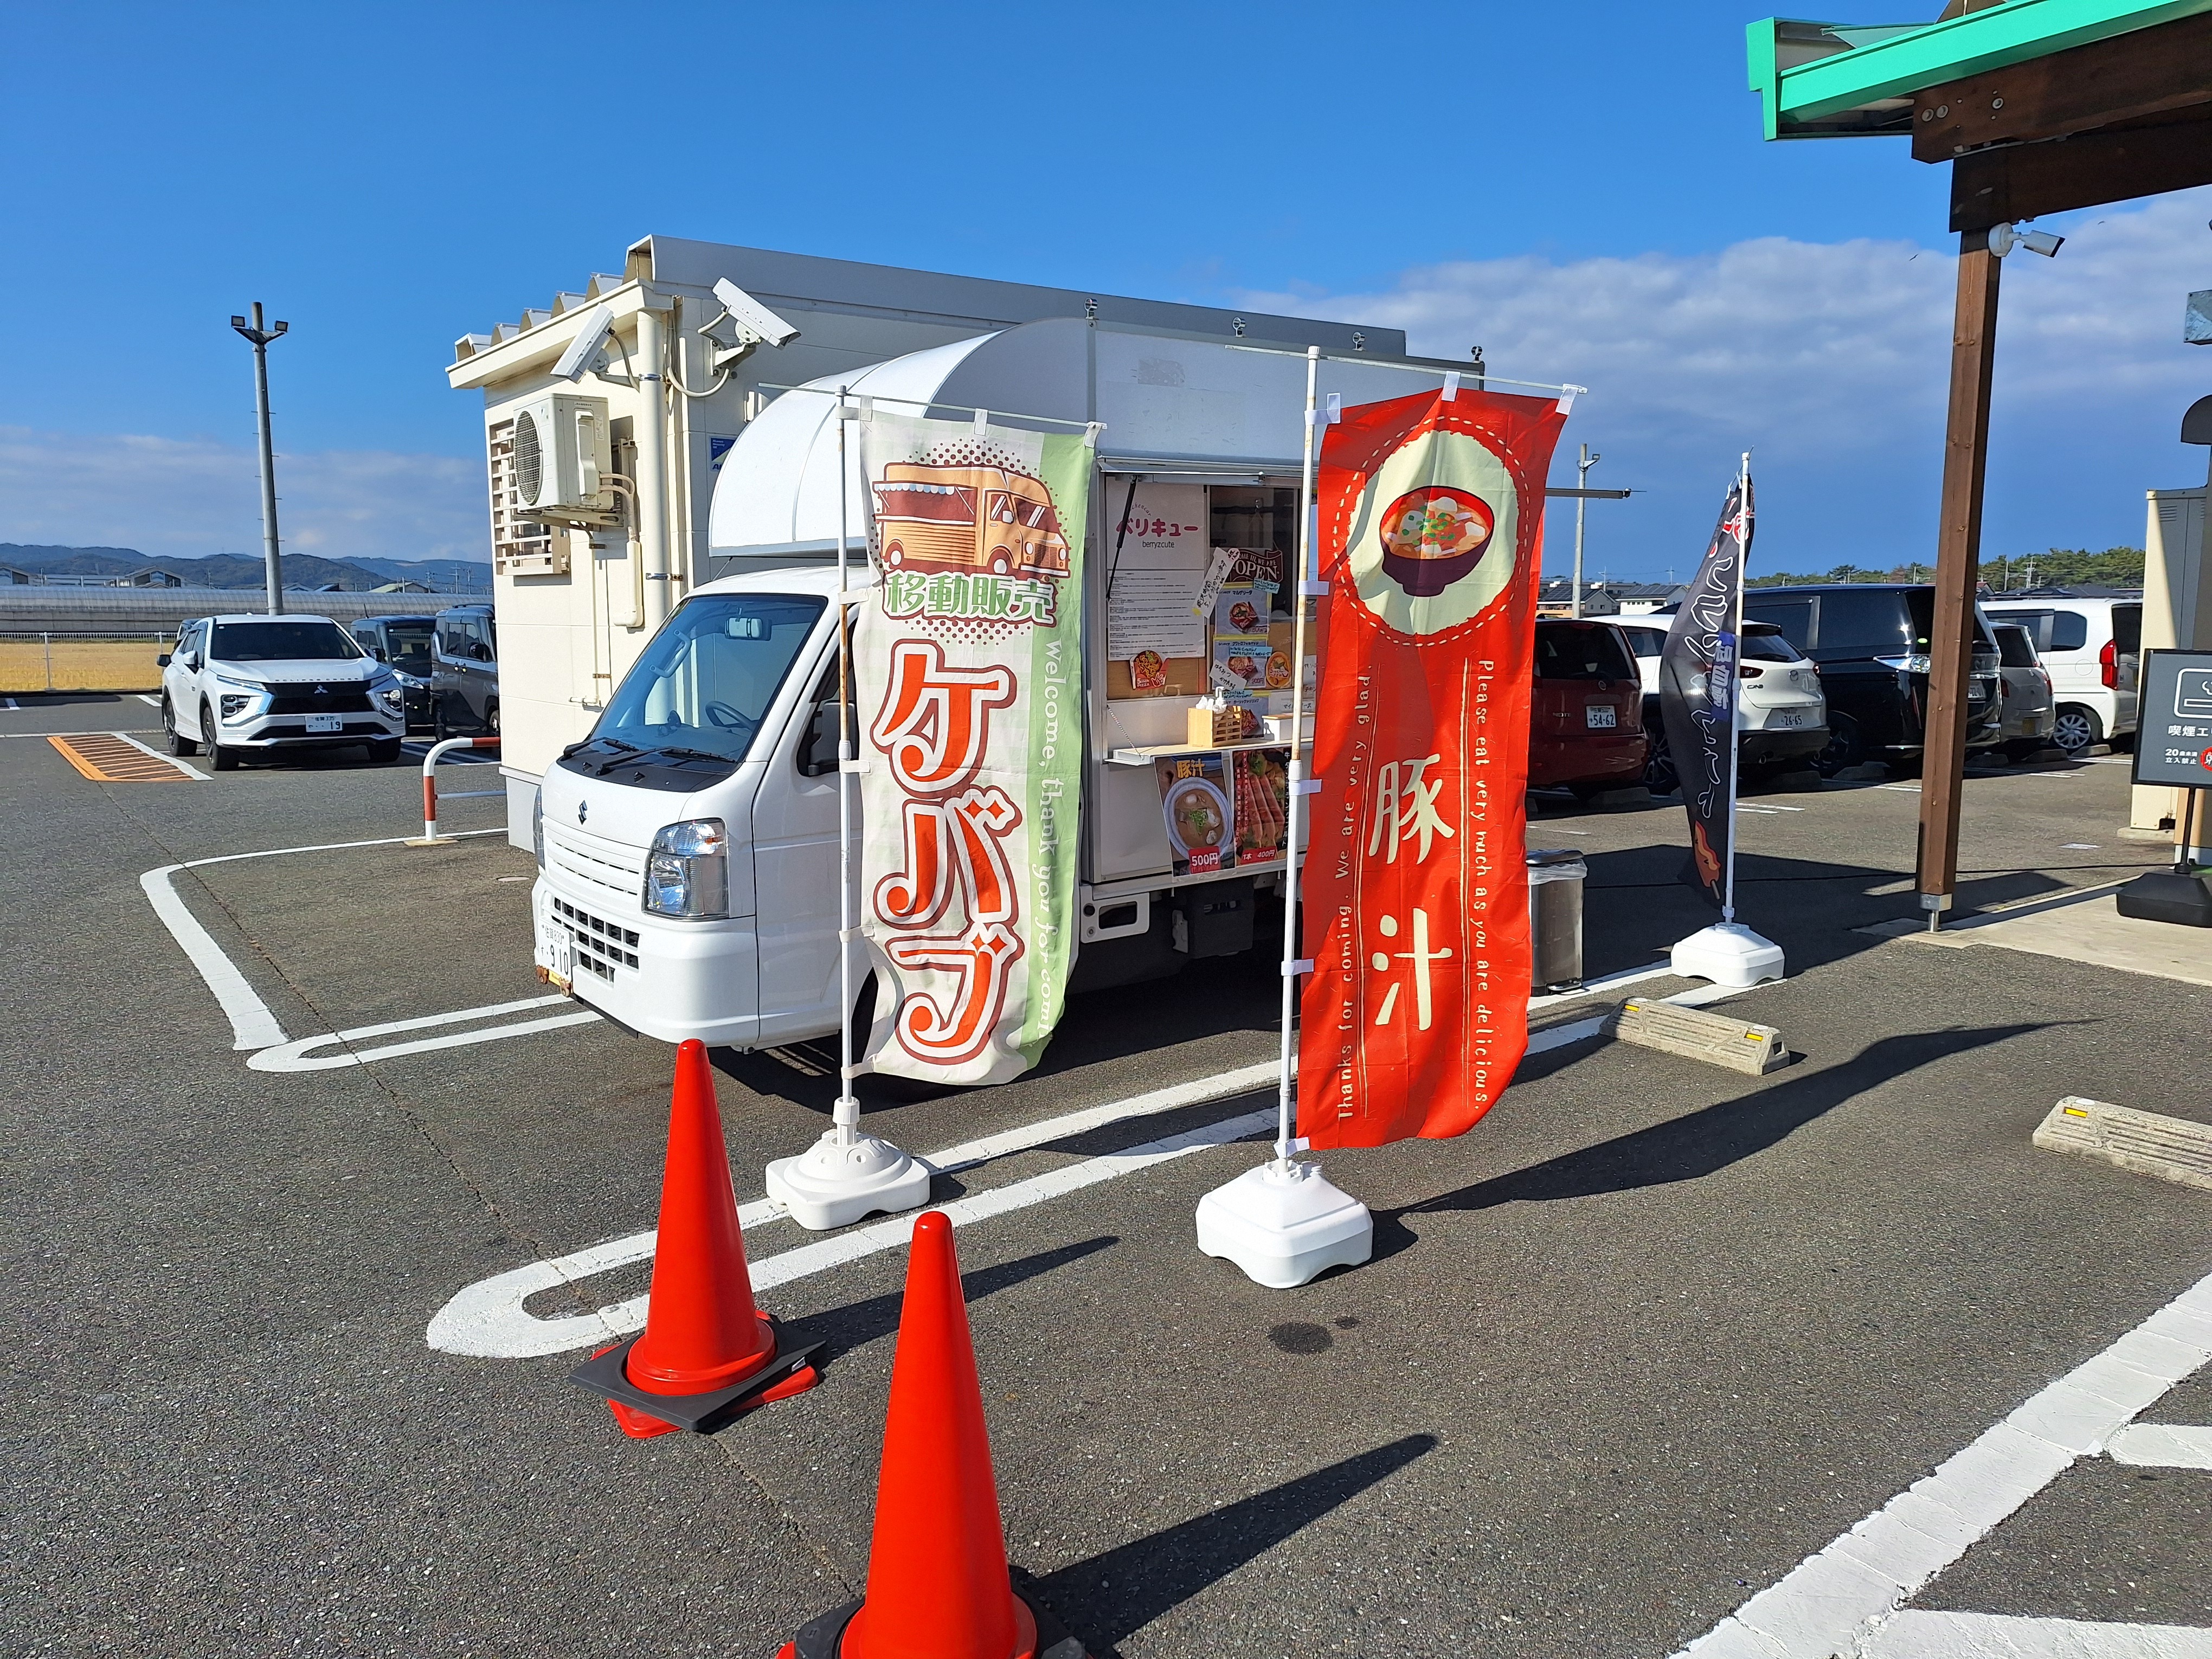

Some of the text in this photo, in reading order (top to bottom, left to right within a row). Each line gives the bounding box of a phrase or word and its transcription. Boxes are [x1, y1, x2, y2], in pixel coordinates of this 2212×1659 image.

[1116, 518, 1199, 537] ベリキュー
[1142, 540, 1175, 549] berryzcute
[1236, 560, 1277, 581] OPEN
[887, 574, 1053, 623] 移動販売
[1039, 639, 1062, 767] Welcome,
[2168, 725, 2212, 737] 喫煙エ
[1176, 758, 1205, 778] 豚汁
[1039, 778, 1064, 856] thank
[877, 646, 1020, 1057] ケバブ
[1192, 852, 1218, 866] 500円
[1257, 850, 1275, 858] 400円
[1035, 864, 1057, 912] you
[1335, 665, 1372, 1121] Thanks for coming. We are very glad.
[1369, 753, 1455, 1031] 豚汁
[1470, 660, 1494, 1110] Please eat very much as you are delicious.
[1038, 916, 1059, 963] for
